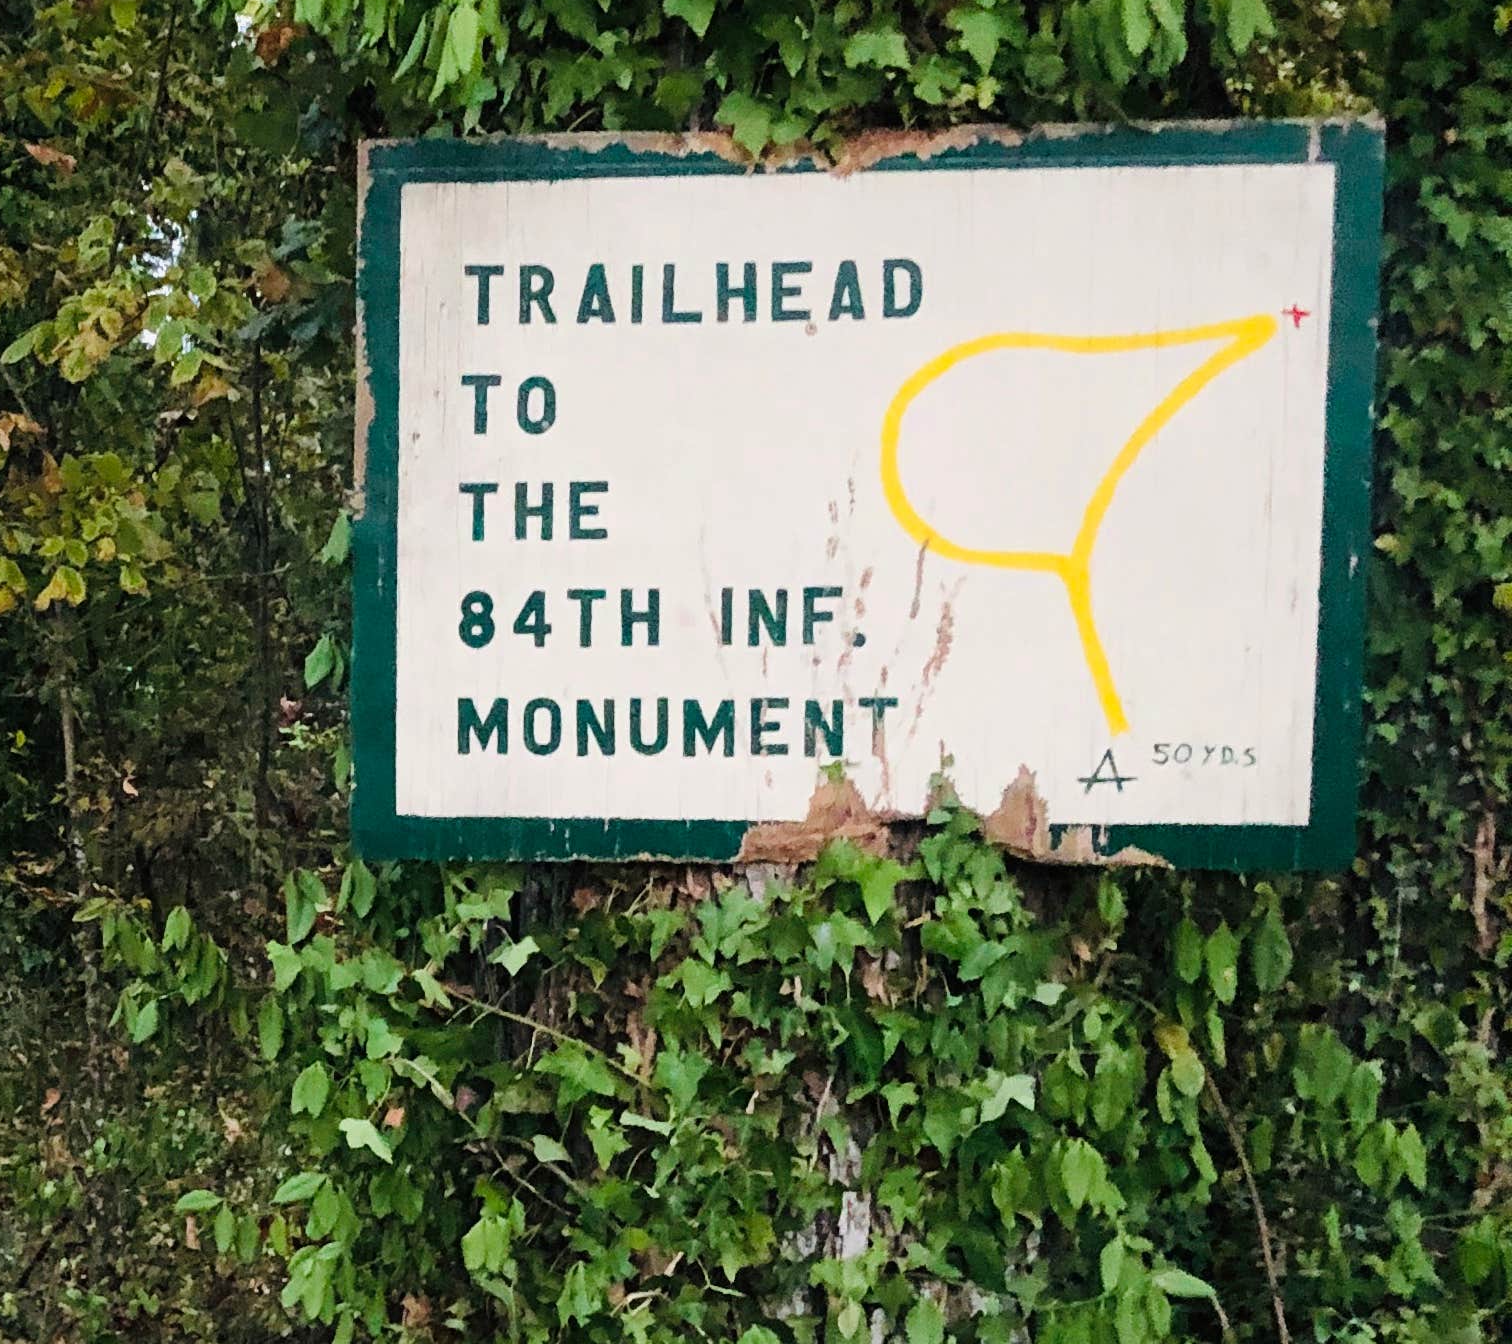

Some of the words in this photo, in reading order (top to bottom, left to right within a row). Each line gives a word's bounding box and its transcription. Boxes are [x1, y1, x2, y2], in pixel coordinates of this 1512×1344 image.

[464, 259, 924, 325] TRAILHEAD
[461, 375, 557, 435] TO
[458, 481, 609, 542] THE
[458, 587, 661, 649] 84TH
[720, 586, 867, 647] INF.
[457, 696, 899, 757] MONUMENT
[1152, 743, 1193, 765] 50
